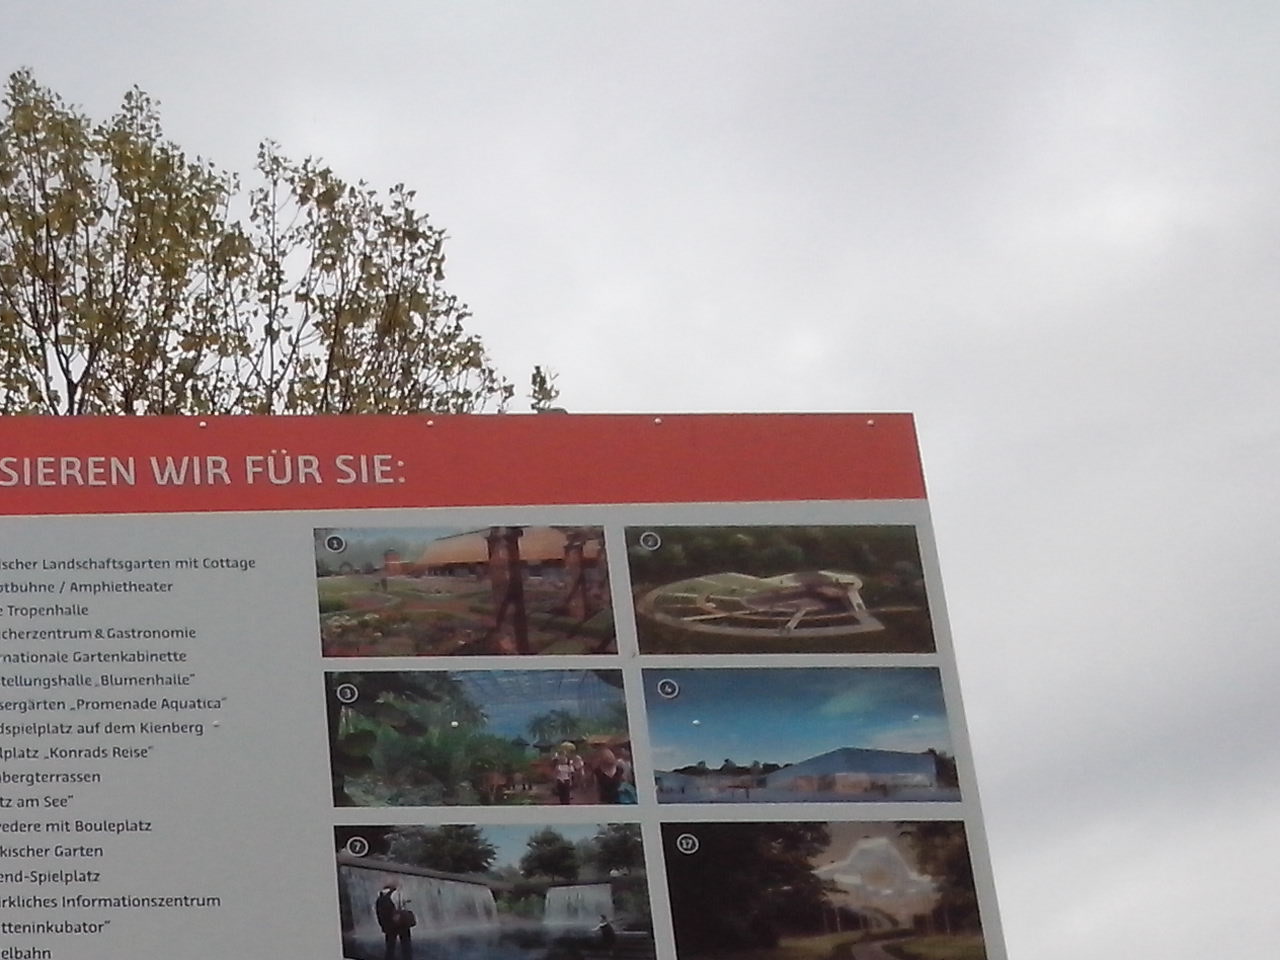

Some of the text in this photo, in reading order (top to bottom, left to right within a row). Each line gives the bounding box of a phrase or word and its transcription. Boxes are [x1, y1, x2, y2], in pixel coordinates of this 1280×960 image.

[149, 455, 232, 486] WIR
[245, 448, 323, 485] FÜR
[335, 454, 406, 484] SIE:
[42, 557, 171, 573] Landschaftsgarten
[174, 557, 199, 569] mit
[202, 557, 256, 572] Cottage
[6, 603, 89, 620] Tropenhalle
[106, 626, 197, 640] Gastronomie
[72, 650, 187, 663] Gartenkabinette
[76, 721, 101, 735] auf
[104, 721, 136, 735] dem
[139, 721, 204, 737] Kienberg
[16, 797, 40, 809] am
[45, 819, 71, 833] mit
[74, 818, 153, 836] Bouleplatz
[54, 844, 104, 858] Garten
[61, 894, 221, 908] Informationszentrum
